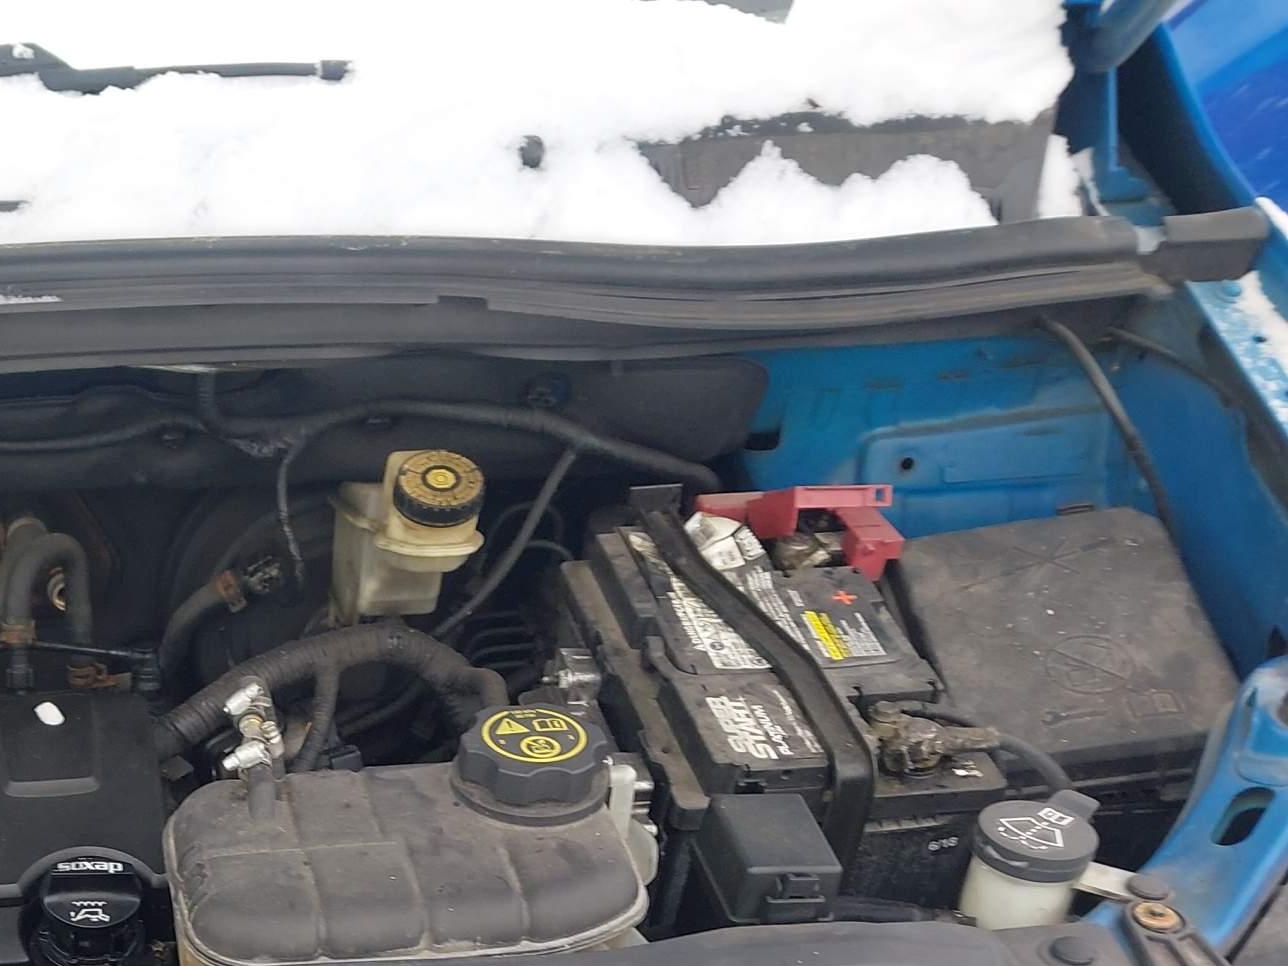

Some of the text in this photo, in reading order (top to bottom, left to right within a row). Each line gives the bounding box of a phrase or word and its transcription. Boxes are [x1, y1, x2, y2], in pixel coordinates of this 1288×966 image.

[705, 696, 747, 753] SUPER
[726, 699, 780, 760] START
[751, 704, 795, 755] PLATINUM
[56, 861, 124, 875] dexos
